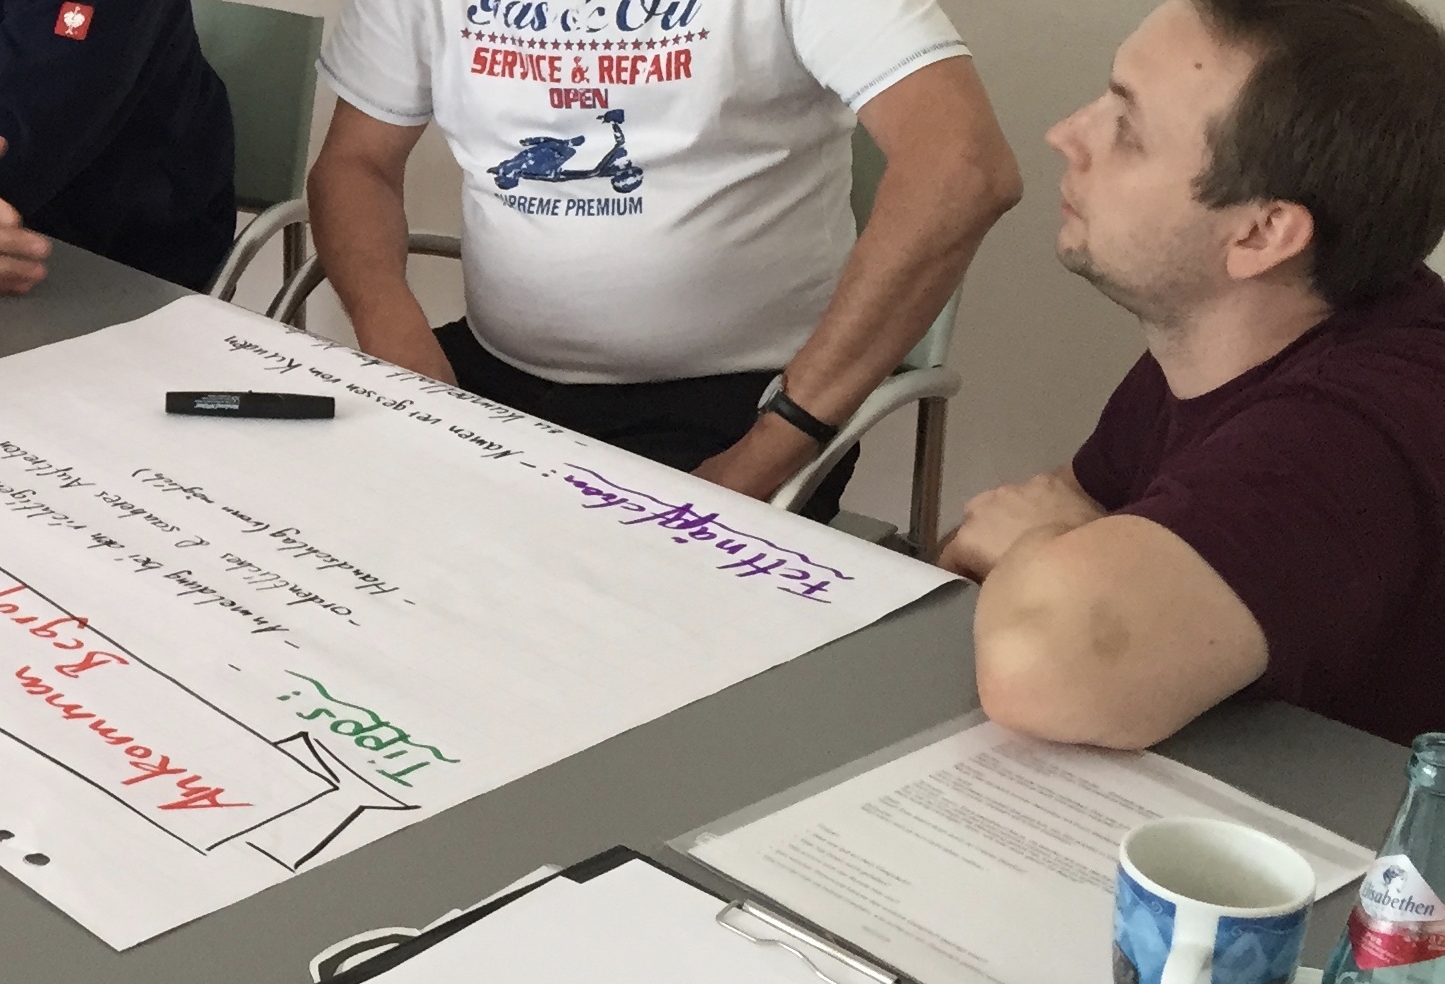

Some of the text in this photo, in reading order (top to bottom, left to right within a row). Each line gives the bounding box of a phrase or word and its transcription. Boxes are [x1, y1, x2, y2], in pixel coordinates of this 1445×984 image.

[471, 47, 562, 83] SERVICE
[571, 56, 590, 84] &
[549, 88, 609, 109] OPEN
[564, 196, 643, 216] PREMIUM
[224, 335, 303, 374] Kunden
[449, 424, 524, 459] Namen
[0, 440, 97, 489] Auftreten
[93, 490, 180, 533] sauberes
[114, 554, 164, 573] bei
[269, 527, 400, 595] Handschlag
[163, 569, 290, 634] Anmeldung
[16, 666, 255, 809] Ankommen
